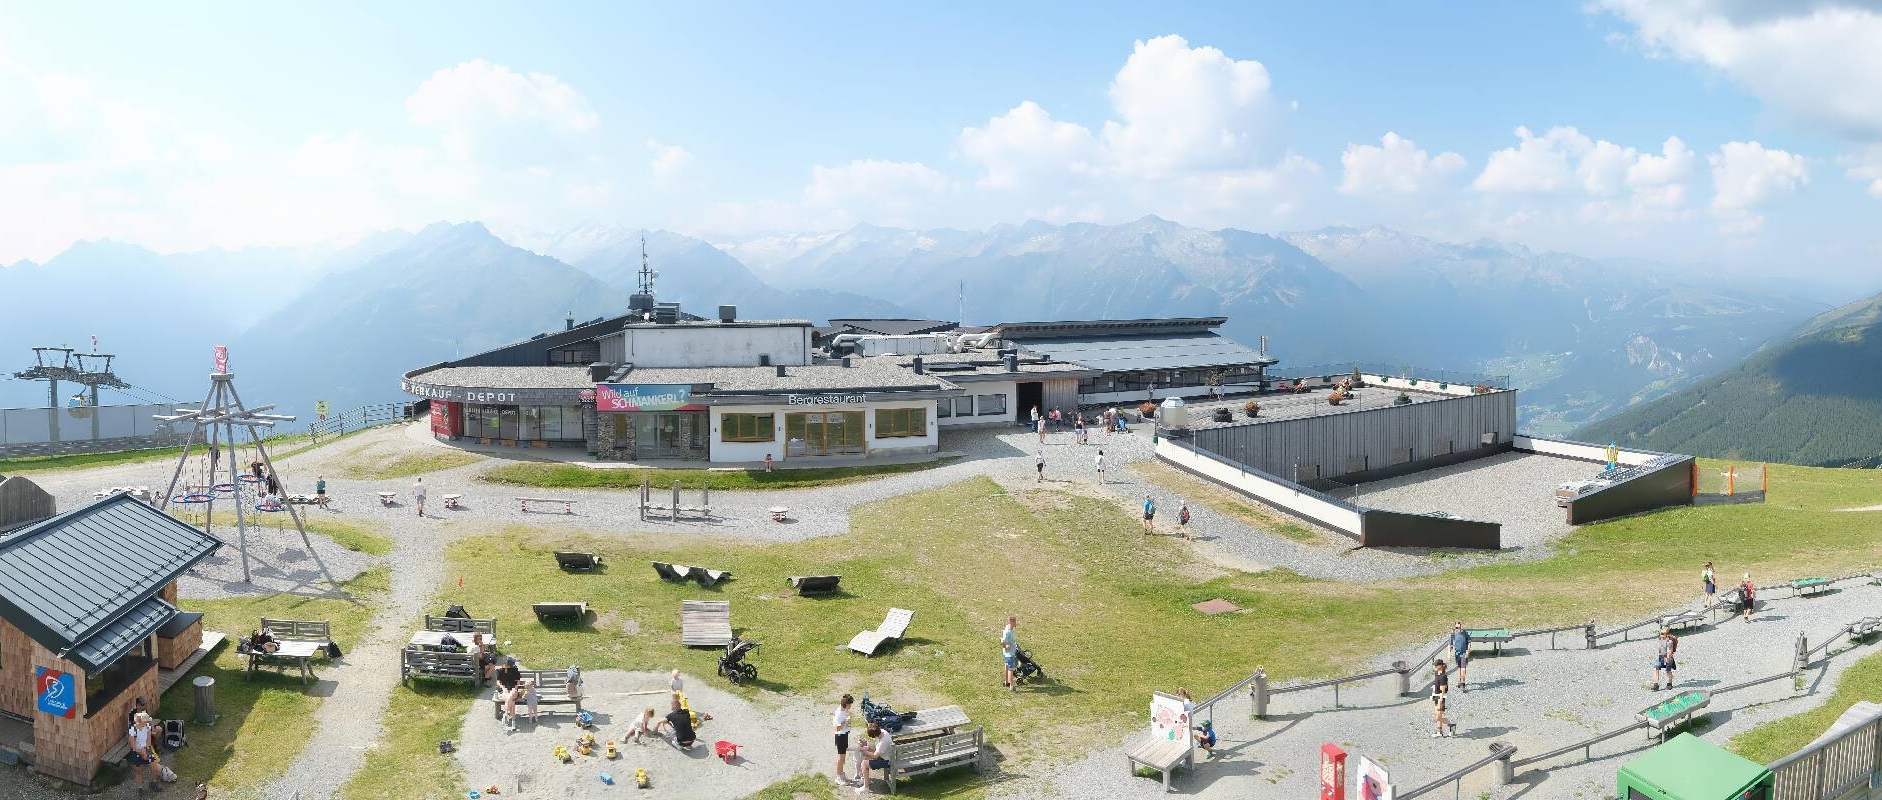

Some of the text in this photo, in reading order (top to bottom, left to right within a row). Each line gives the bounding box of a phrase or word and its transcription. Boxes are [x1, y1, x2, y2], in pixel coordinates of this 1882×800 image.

[411, 385, 452, 399] VERKAUF
[467, 393, 516, 402] DEPOT
[601, 389, 622, 400] Wild
[623, 387, 639, 397] auf
[788, 393, 867, 406] Bergrestaurant
